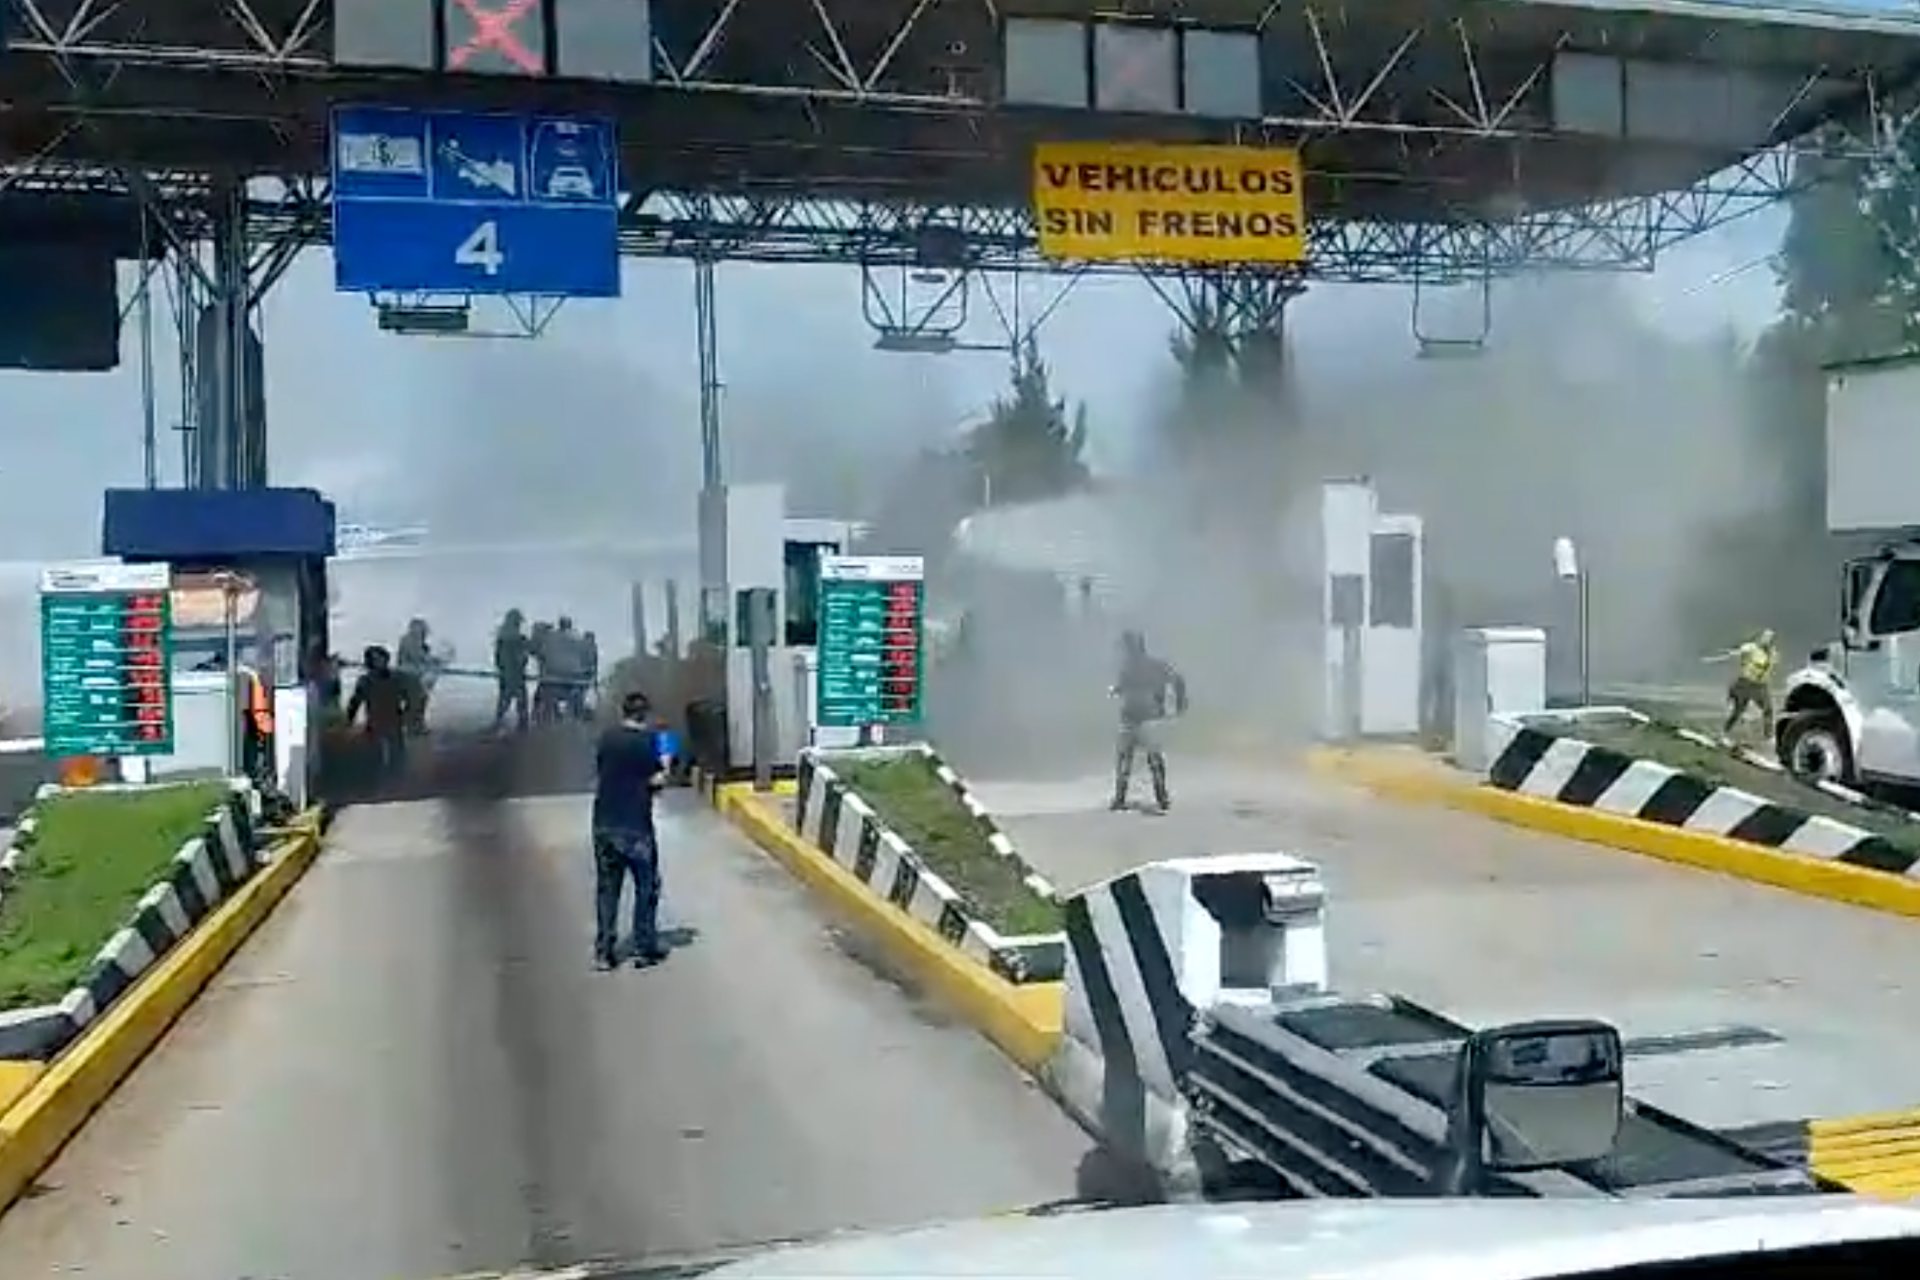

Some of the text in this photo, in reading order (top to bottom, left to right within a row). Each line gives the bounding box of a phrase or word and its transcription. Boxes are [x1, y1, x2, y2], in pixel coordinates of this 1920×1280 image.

[1041, 162, 1294, 195] VEHICULOS
[1045, 208, 1297, 238] SIN FRENOS
[455, 221, 504, 275] 4
